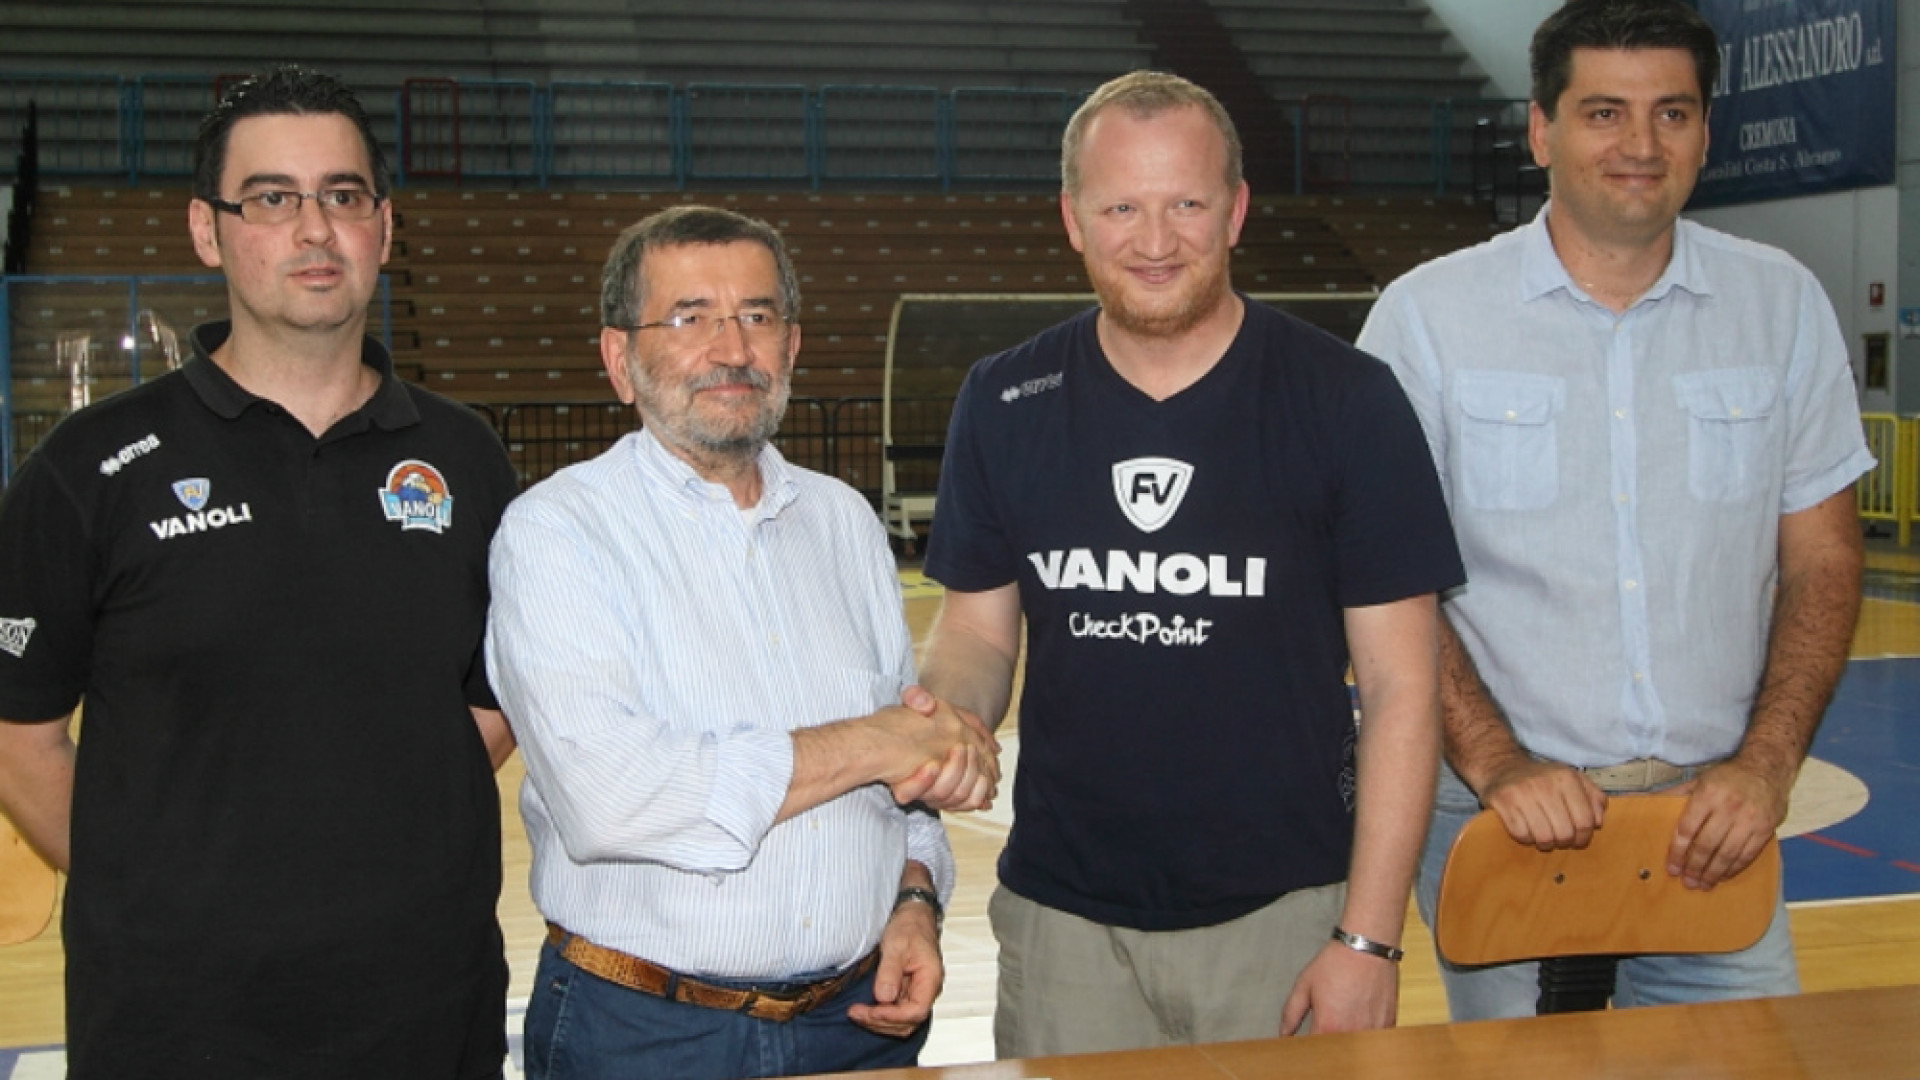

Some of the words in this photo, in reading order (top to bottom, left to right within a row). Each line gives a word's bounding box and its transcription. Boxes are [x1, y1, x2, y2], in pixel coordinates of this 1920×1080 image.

[1740, 12, 1863, 92] ALESSANDRO
[1130, 472, 1179, 505] FV
[150, 502, 252, 540] VANOLI
[1026, 548, 1267, 597] VANOLI
